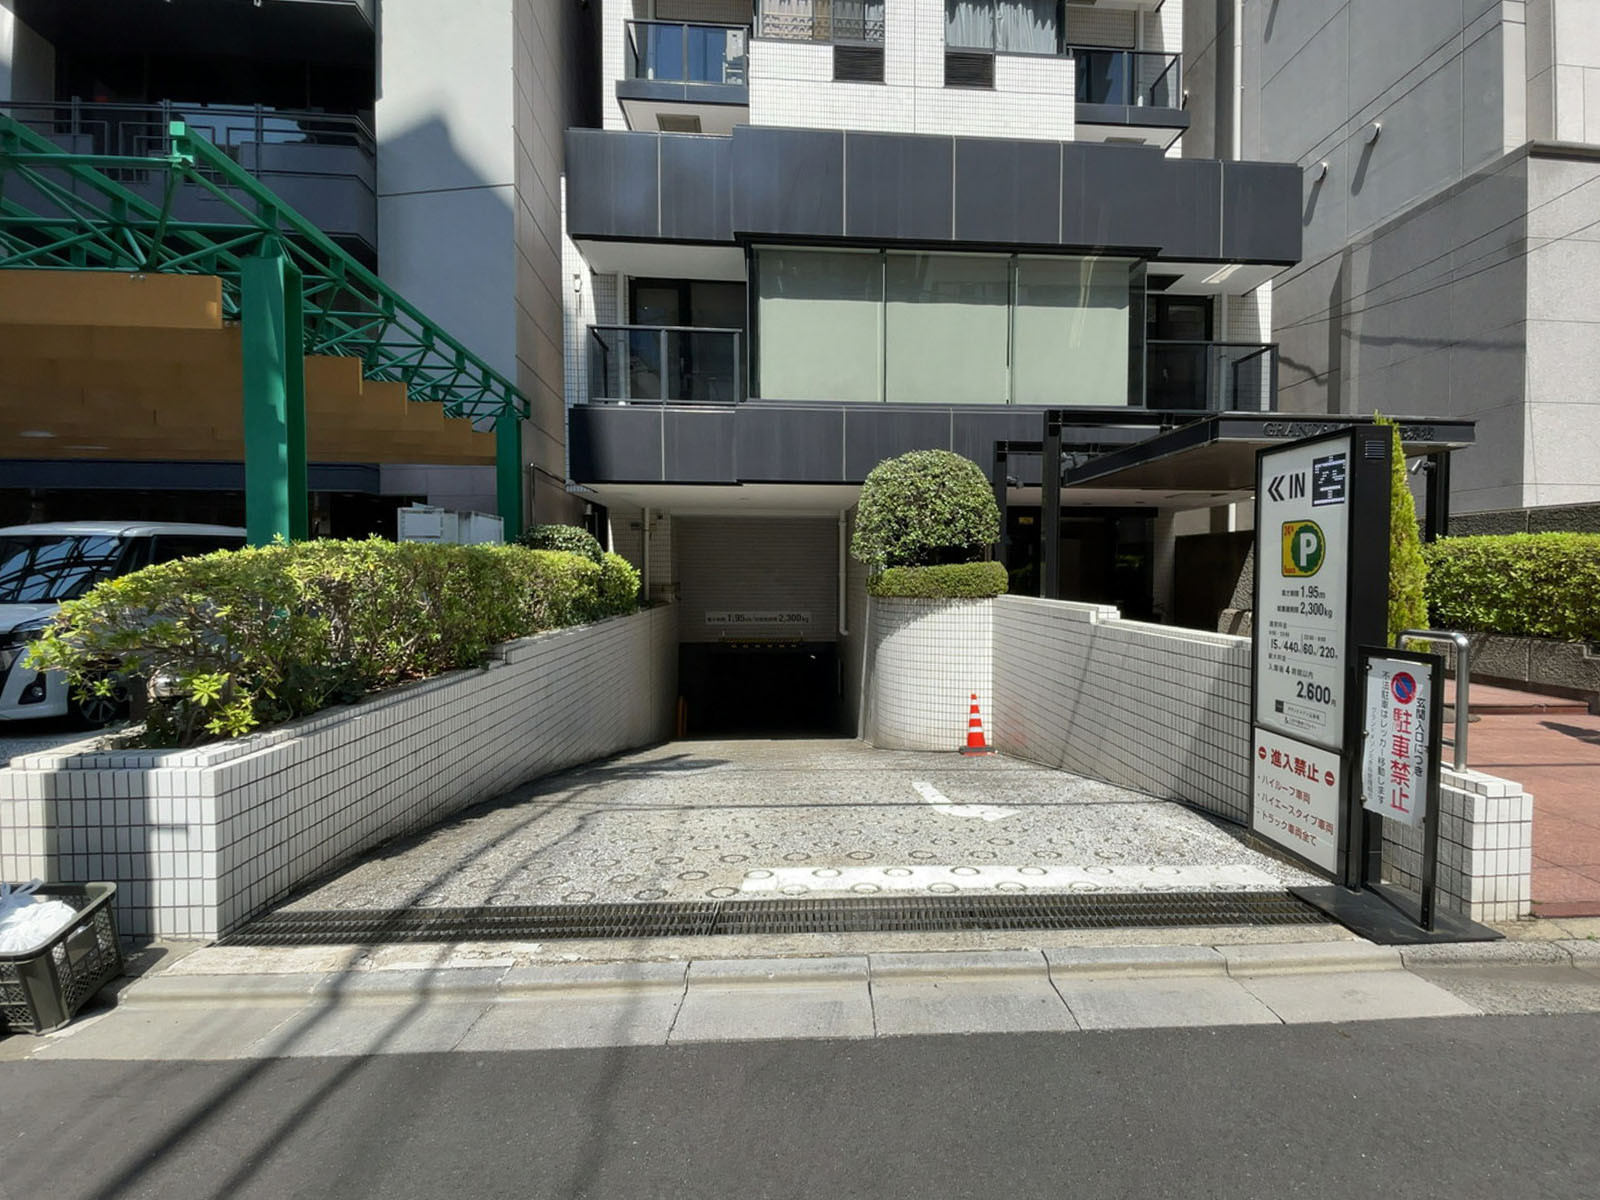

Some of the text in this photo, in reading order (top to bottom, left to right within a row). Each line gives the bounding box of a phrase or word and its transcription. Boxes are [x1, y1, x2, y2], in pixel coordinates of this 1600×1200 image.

[1289, 472, 1306, 500] IN
[1314, 455, 1345, 504] 空
[1300, 532, 1318, 567] P
[1413, 697, 1426, 778] 玄関入口につき
[1270, 748, 1320, 783] 進入禁止
[1391, 707, 1413, 814] 駐車禁止
